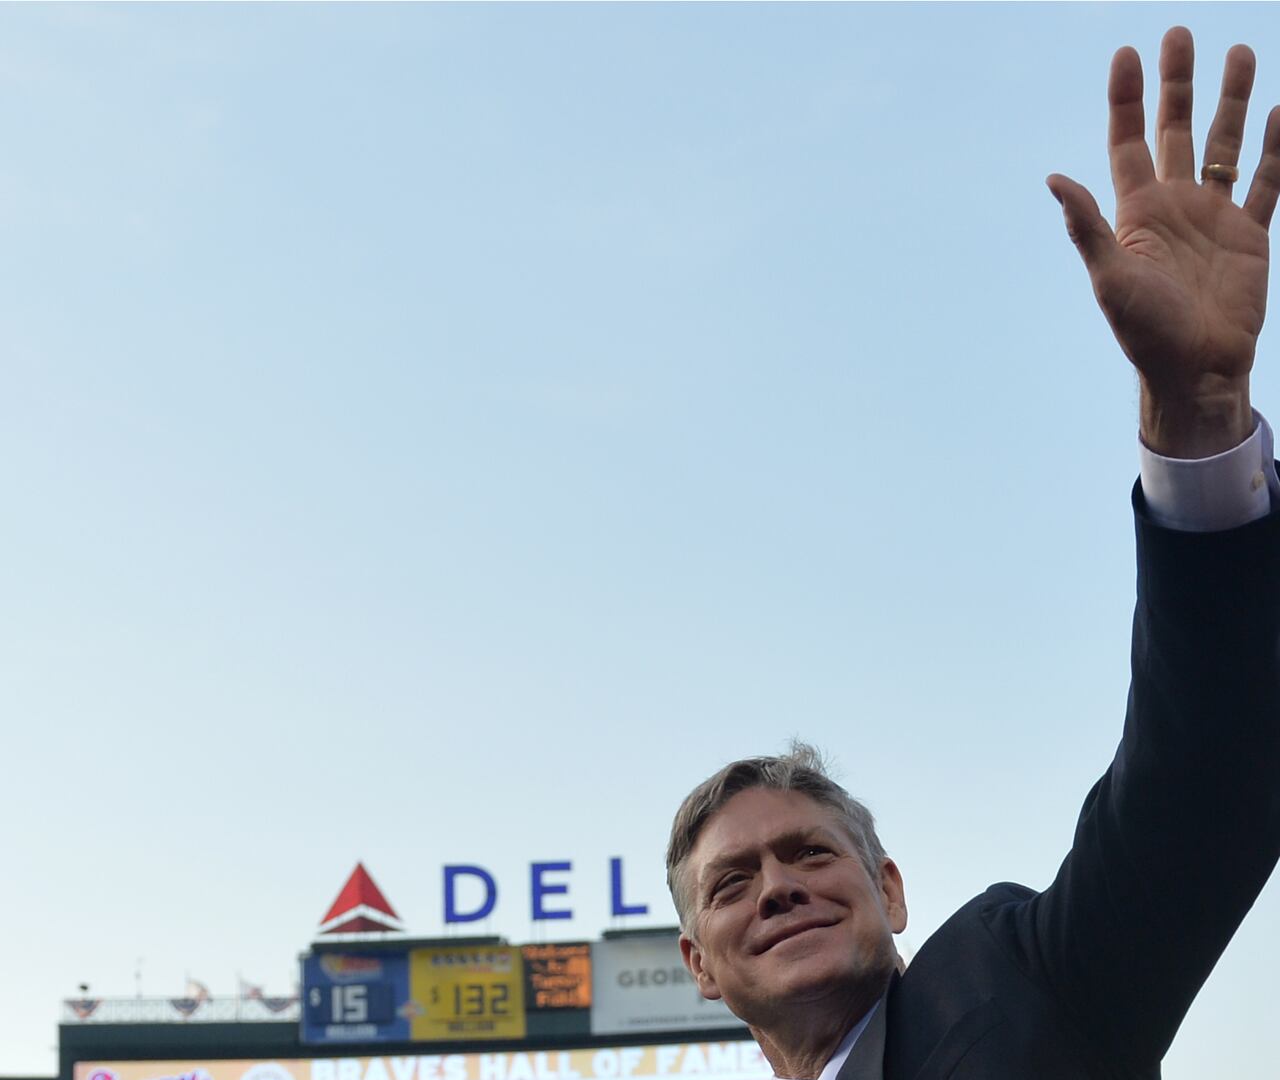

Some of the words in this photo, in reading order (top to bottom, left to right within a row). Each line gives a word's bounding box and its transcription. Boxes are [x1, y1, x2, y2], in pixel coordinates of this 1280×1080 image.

[442, 857, 650, 924] DEL
[617, 968, 693, 988] GEOR
[331, 984, 369, 1023] 15
[454, 984, 510, 1016] 132
[592, 1047, 643, 1078] OF
[657, 1040, 766, 1074] FAME
